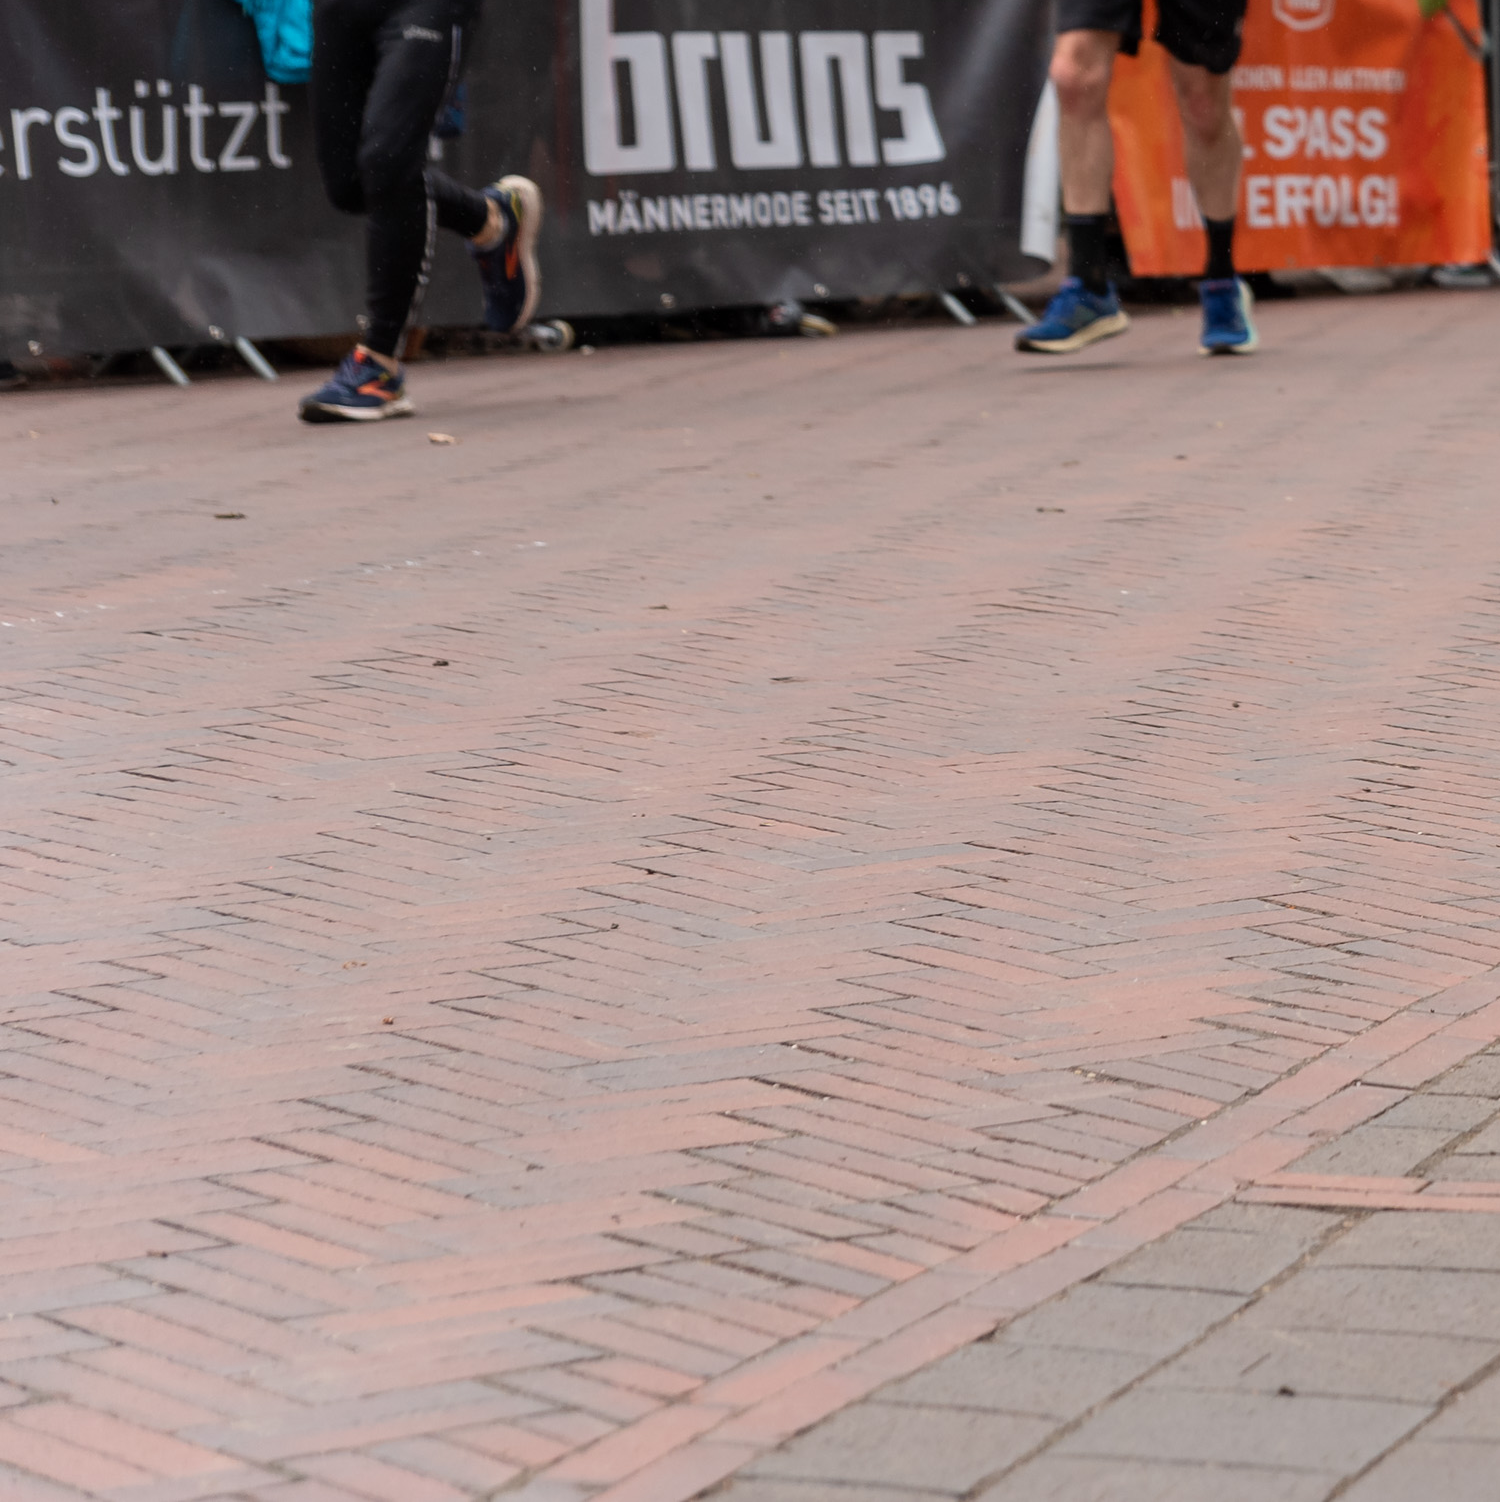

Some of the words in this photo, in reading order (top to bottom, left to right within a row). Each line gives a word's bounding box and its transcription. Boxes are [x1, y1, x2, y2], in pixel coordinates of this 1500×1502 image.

[0, 79, 293, 180] rstützt
[588, 190, 814, 236] MÄNNERMODE
[817, 188, 880, 225] SEIT
[884, 182, 961, 221] 1896
